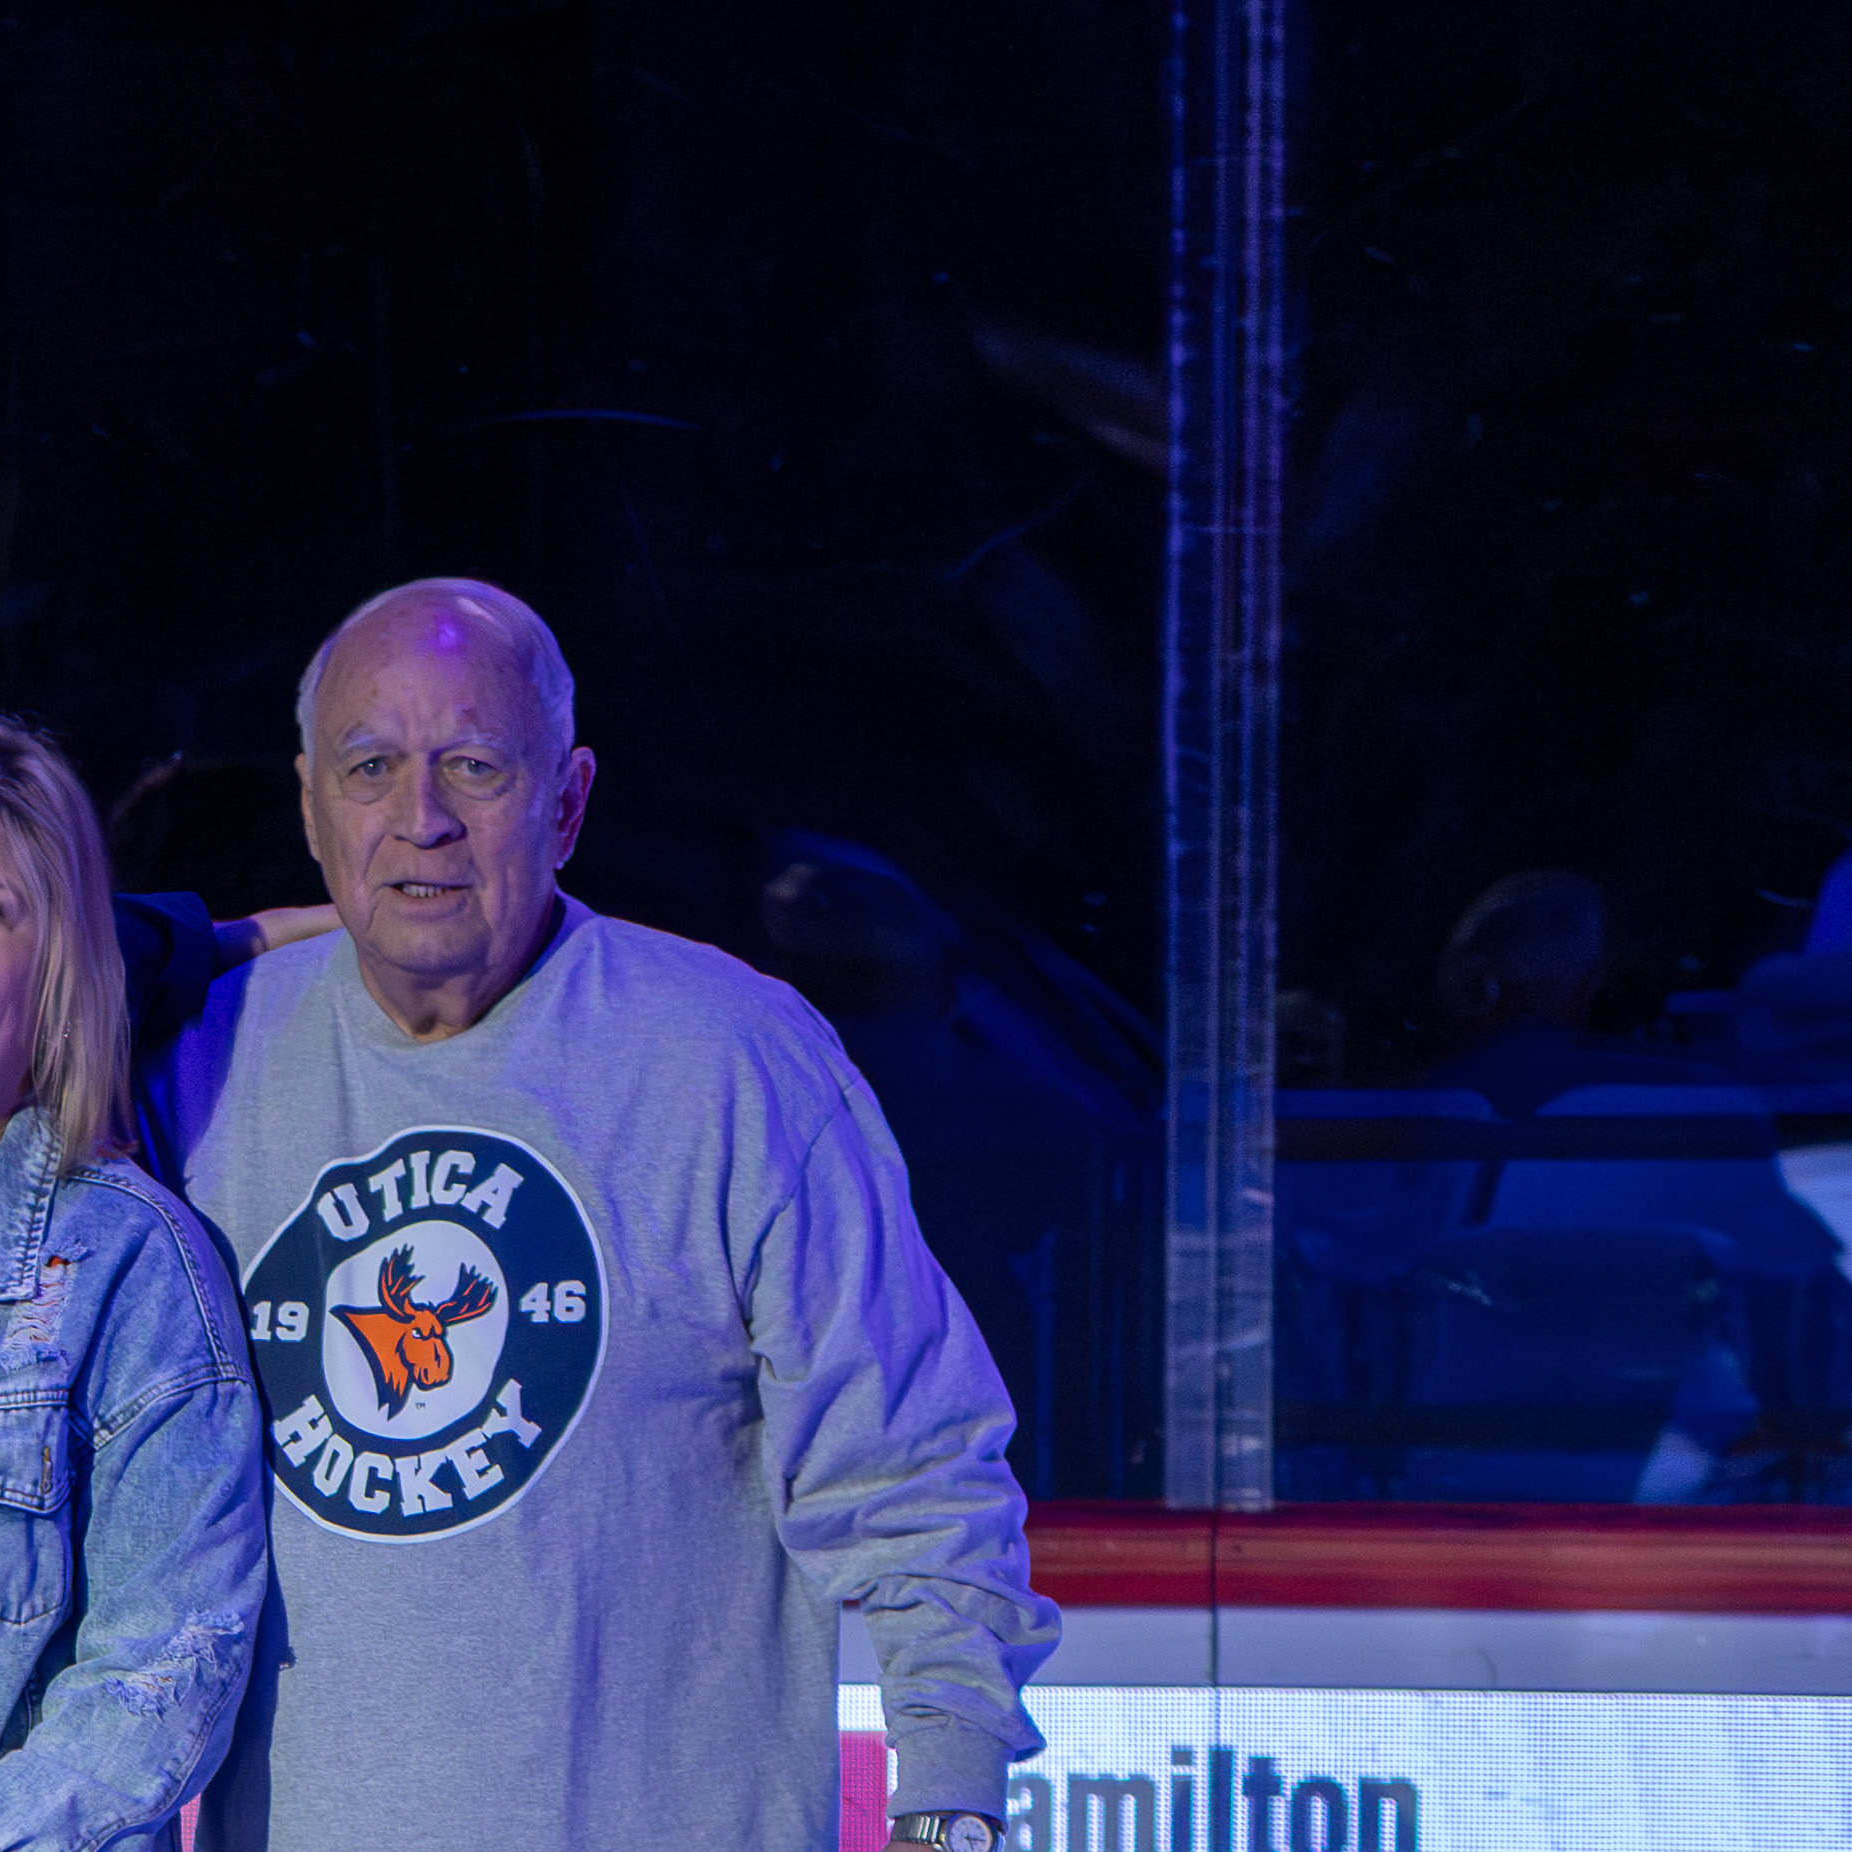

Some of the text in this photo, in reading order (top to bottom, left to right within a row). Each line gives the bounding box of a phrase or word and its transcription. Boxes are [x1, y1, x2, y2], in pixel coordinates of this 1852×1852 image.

[317, 1149, 524, 1242] UTICA
[251, 1279, 588, 1342] 19 46
[271, 1378, 543, 1517] HOCKEY
